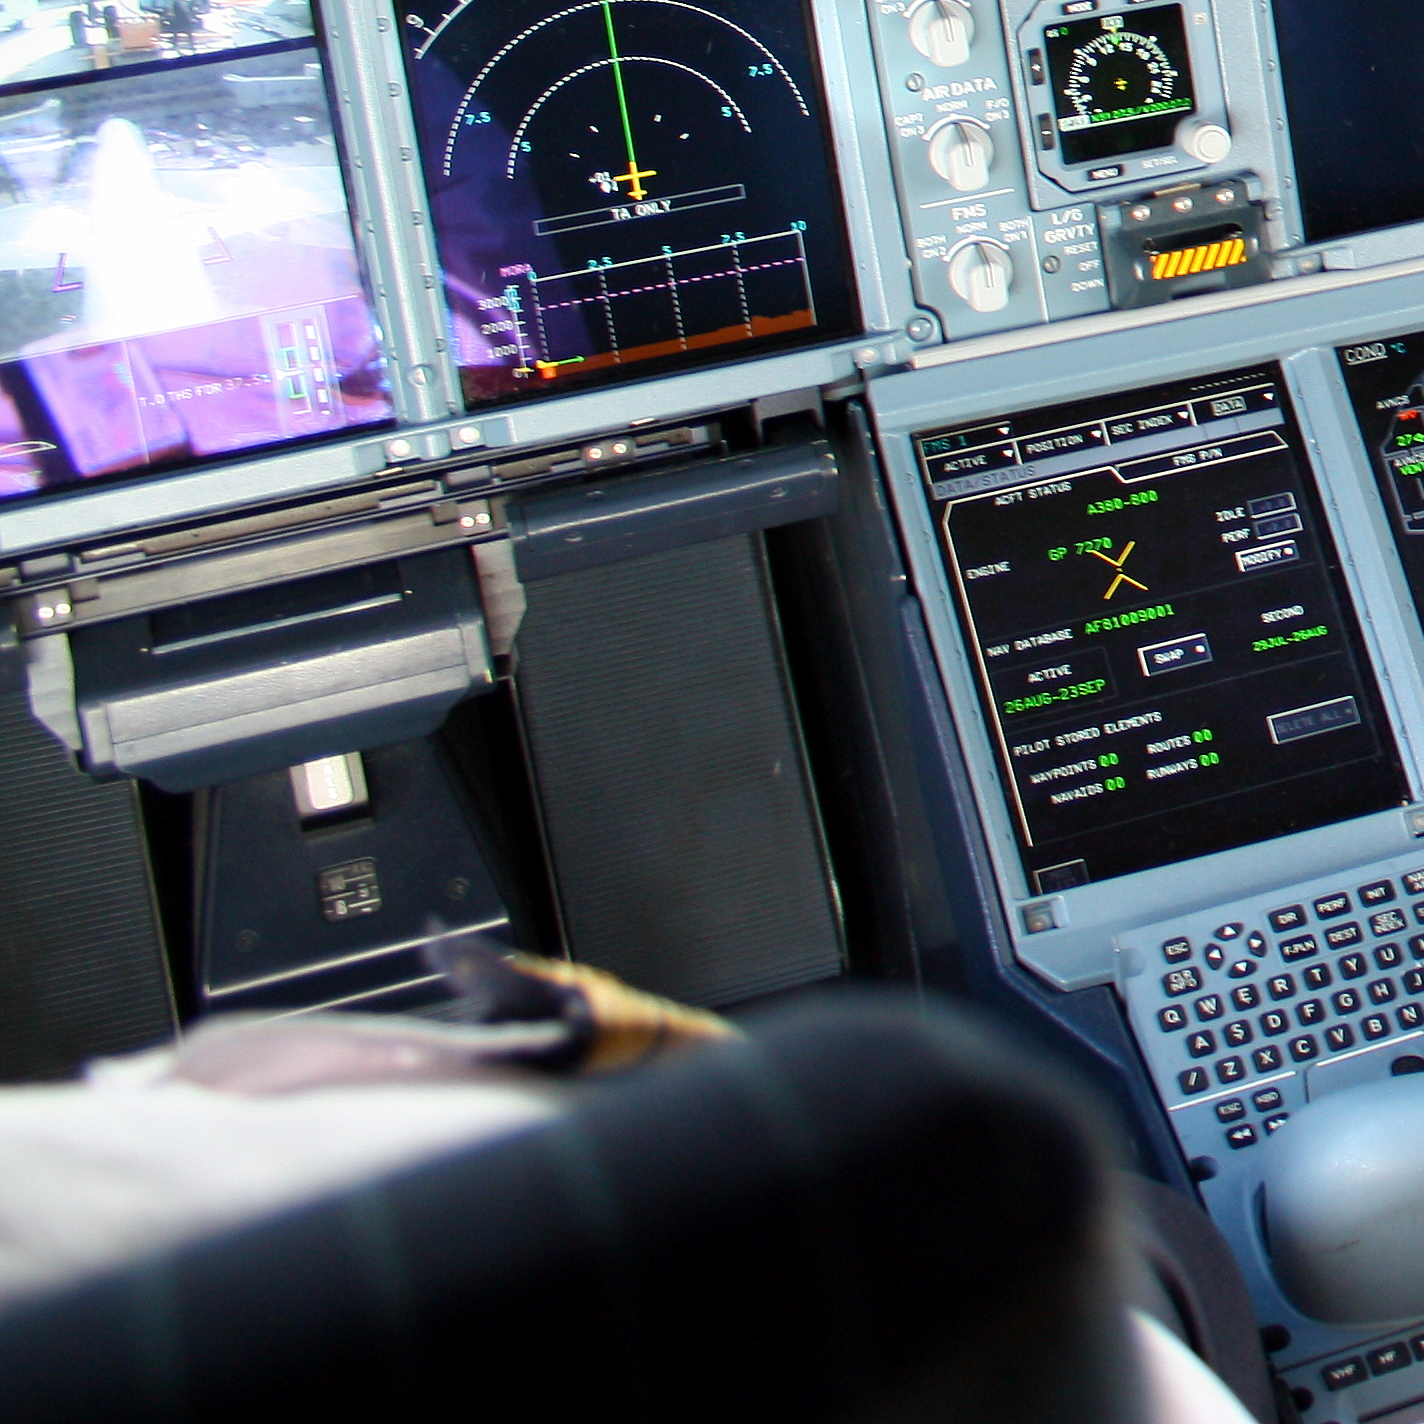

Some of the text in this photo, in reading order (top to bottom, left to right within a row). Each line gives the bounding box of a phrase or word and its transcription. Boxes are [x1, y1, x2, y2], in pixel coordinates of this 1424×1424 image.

[922, 78, 996, 101] AIR DATA
[612, 199, 672, 220] TA ONLY
[952, 205, 987, 220] FMS
[1051, 209, 1082, 225] L/G
[1044, 223, 1096, 242] GRVTY
[1344, 343, 1386, 365] COND
[1110, 415, 1173, 436] SEC INDEX
[1026, 434, 1084, 454] POSITION
[943, 454, 988, 472] ACTIVE
[935, 465, 1035, 497] DATA/STATUS
[1029, 482, 1072, 501] STATUS
[966, 561, 1011, 580] ENGINE
[1260, 605, 1304, 624] SECOND
[986, 628, 1073, 658] NAV DATABASE
[1154, 648, 1184, 665] SWAP
[1027, 664, 1073, 684] ACTIVE
[1012, 712, 1162, 758] PILOT STORED ELEMENTS
[1145, 734, 1191, 754] ROUTES
[1029, 759, 1098, 784] WAYPOINTS
[1145, 758, 1198, 780] RUNWAYS
[1051, 784, 1103, 805] NAVAIDS
[1310, 968, 1323, 983] T
[1273, 978, 1289, 994] R
[1237, 989, 1252, 1004] E
[1200, 999, 1218, 1014] W
[1165, 1010, 1181, 1025] Q
[1193, 1035, 1210, 1050] A
